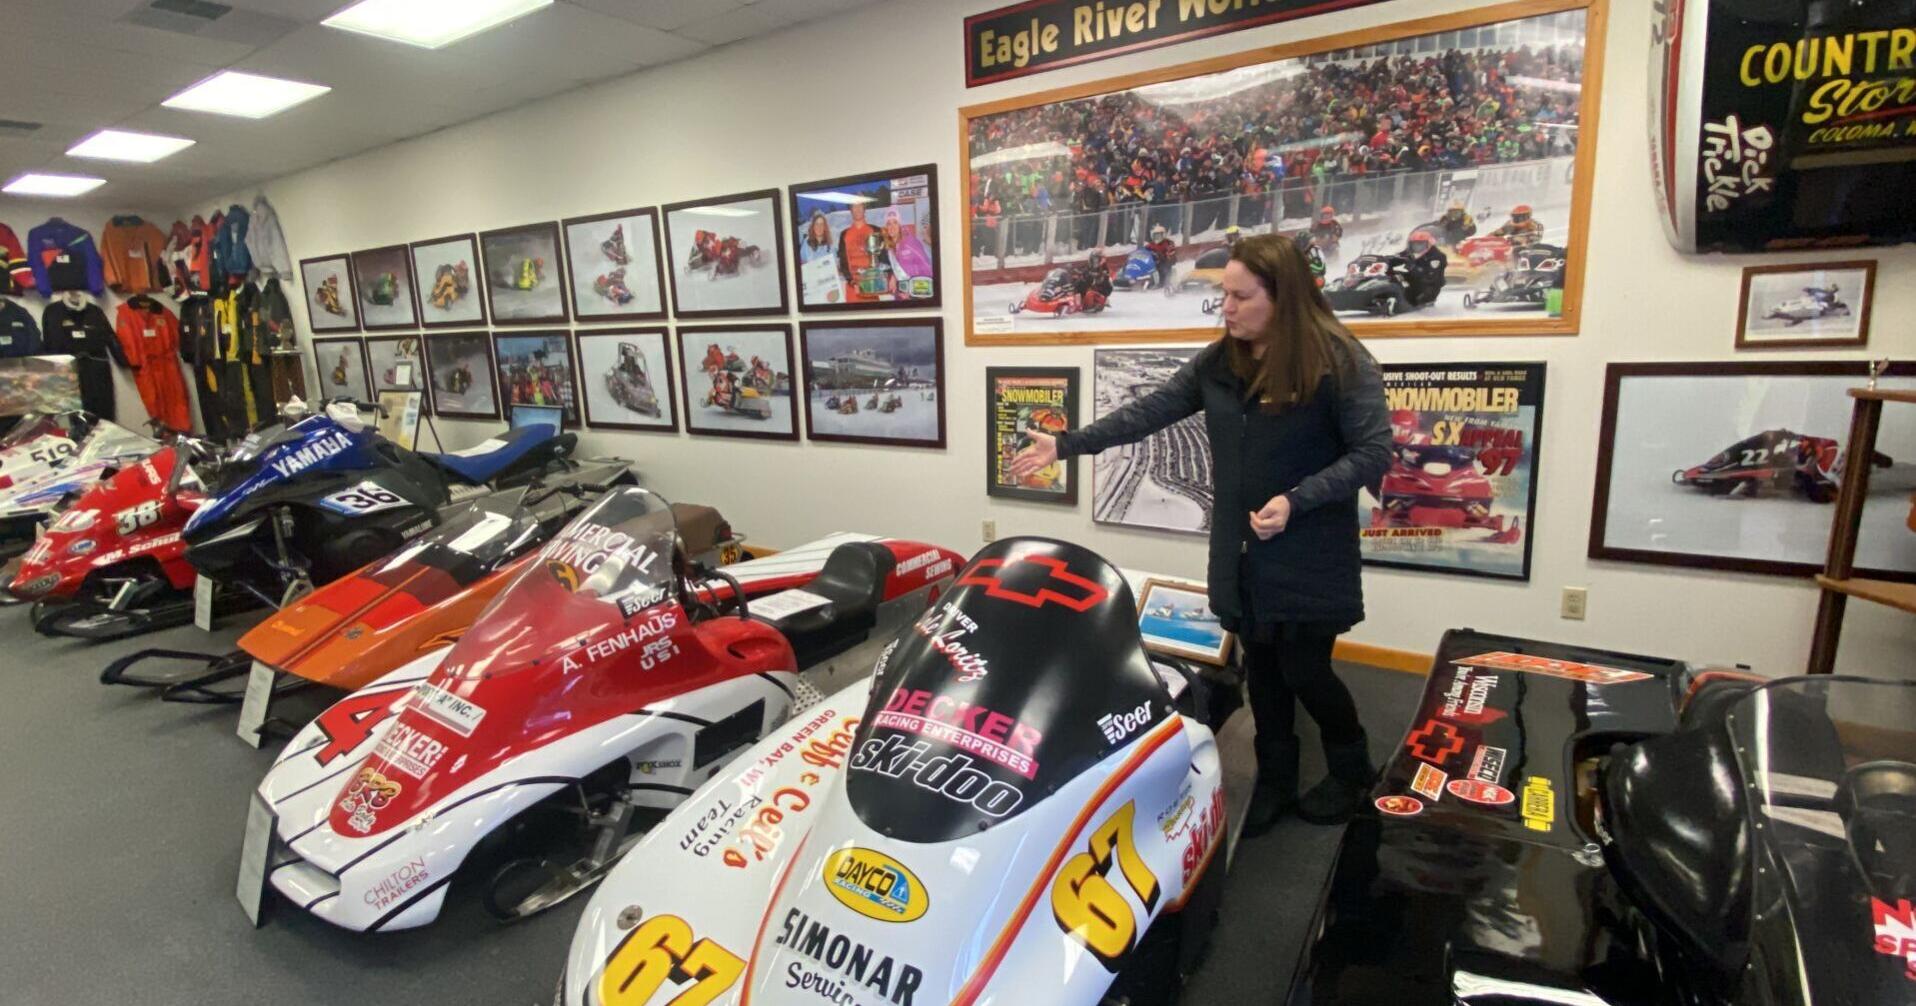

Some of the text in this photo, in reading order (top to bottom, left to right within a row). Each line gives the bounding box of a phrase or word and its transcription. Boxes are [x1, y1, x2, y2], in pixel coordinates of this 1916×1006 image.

[980, 18, 1058, 68] Eagle
[1073, 0, 1159, 46] River
[1702, 115, 1741, 213] Trickle
[1742, 126, 1773, 194] Dick
[1002, 389, 1064, 404] SNOWMOBILER
[1405, 371, 1445, 381] SHOOT-OUT
[1447, 371, 1477, 381] RESULTS
[31, 443, 73, 463] 519
[1431, 421, 1466, 446] SX
[272, 431, 353, 478] YAMAHA
[1741, 449, 1768, 466] 22
[336, 486, 400, 510] 36
[117, 502, 158, 536] 38
[1362, 529, 1442, 538] JUST ARRIVED
[943, 601, 979, 634] DRIVER
[562, 655, 582, 675] A.
[640, 635, 673, 659] JRS
[314, 686, 417, 767] 4
[448, 699, 473, 719] INC.
[792, 709, 837, 743] GREEN
[884, 686, 1042, 756] DECKER
[1113, 700, 1152, 741] Seer
[759, 742, 794, 767] BAY,
[875, 713, 1030, 774] RACING ENTERPRISES
[851, 734, 1024, 817] ski-doo
[679, 798, 732, 851] Team
[693, 795, 763, 857] Racing
[364, 856, 427, 906] CHILTON
[374, 870, 430, 912] TRAILERS
[837, 856, 897, 897] DAYCO
[1051, 799, 1160, 973] 67
[598, 914, 747, 1006] 67
[775, 907, 923, 1006] SIMONAR
[785, 961, 866, 1006] Servic
